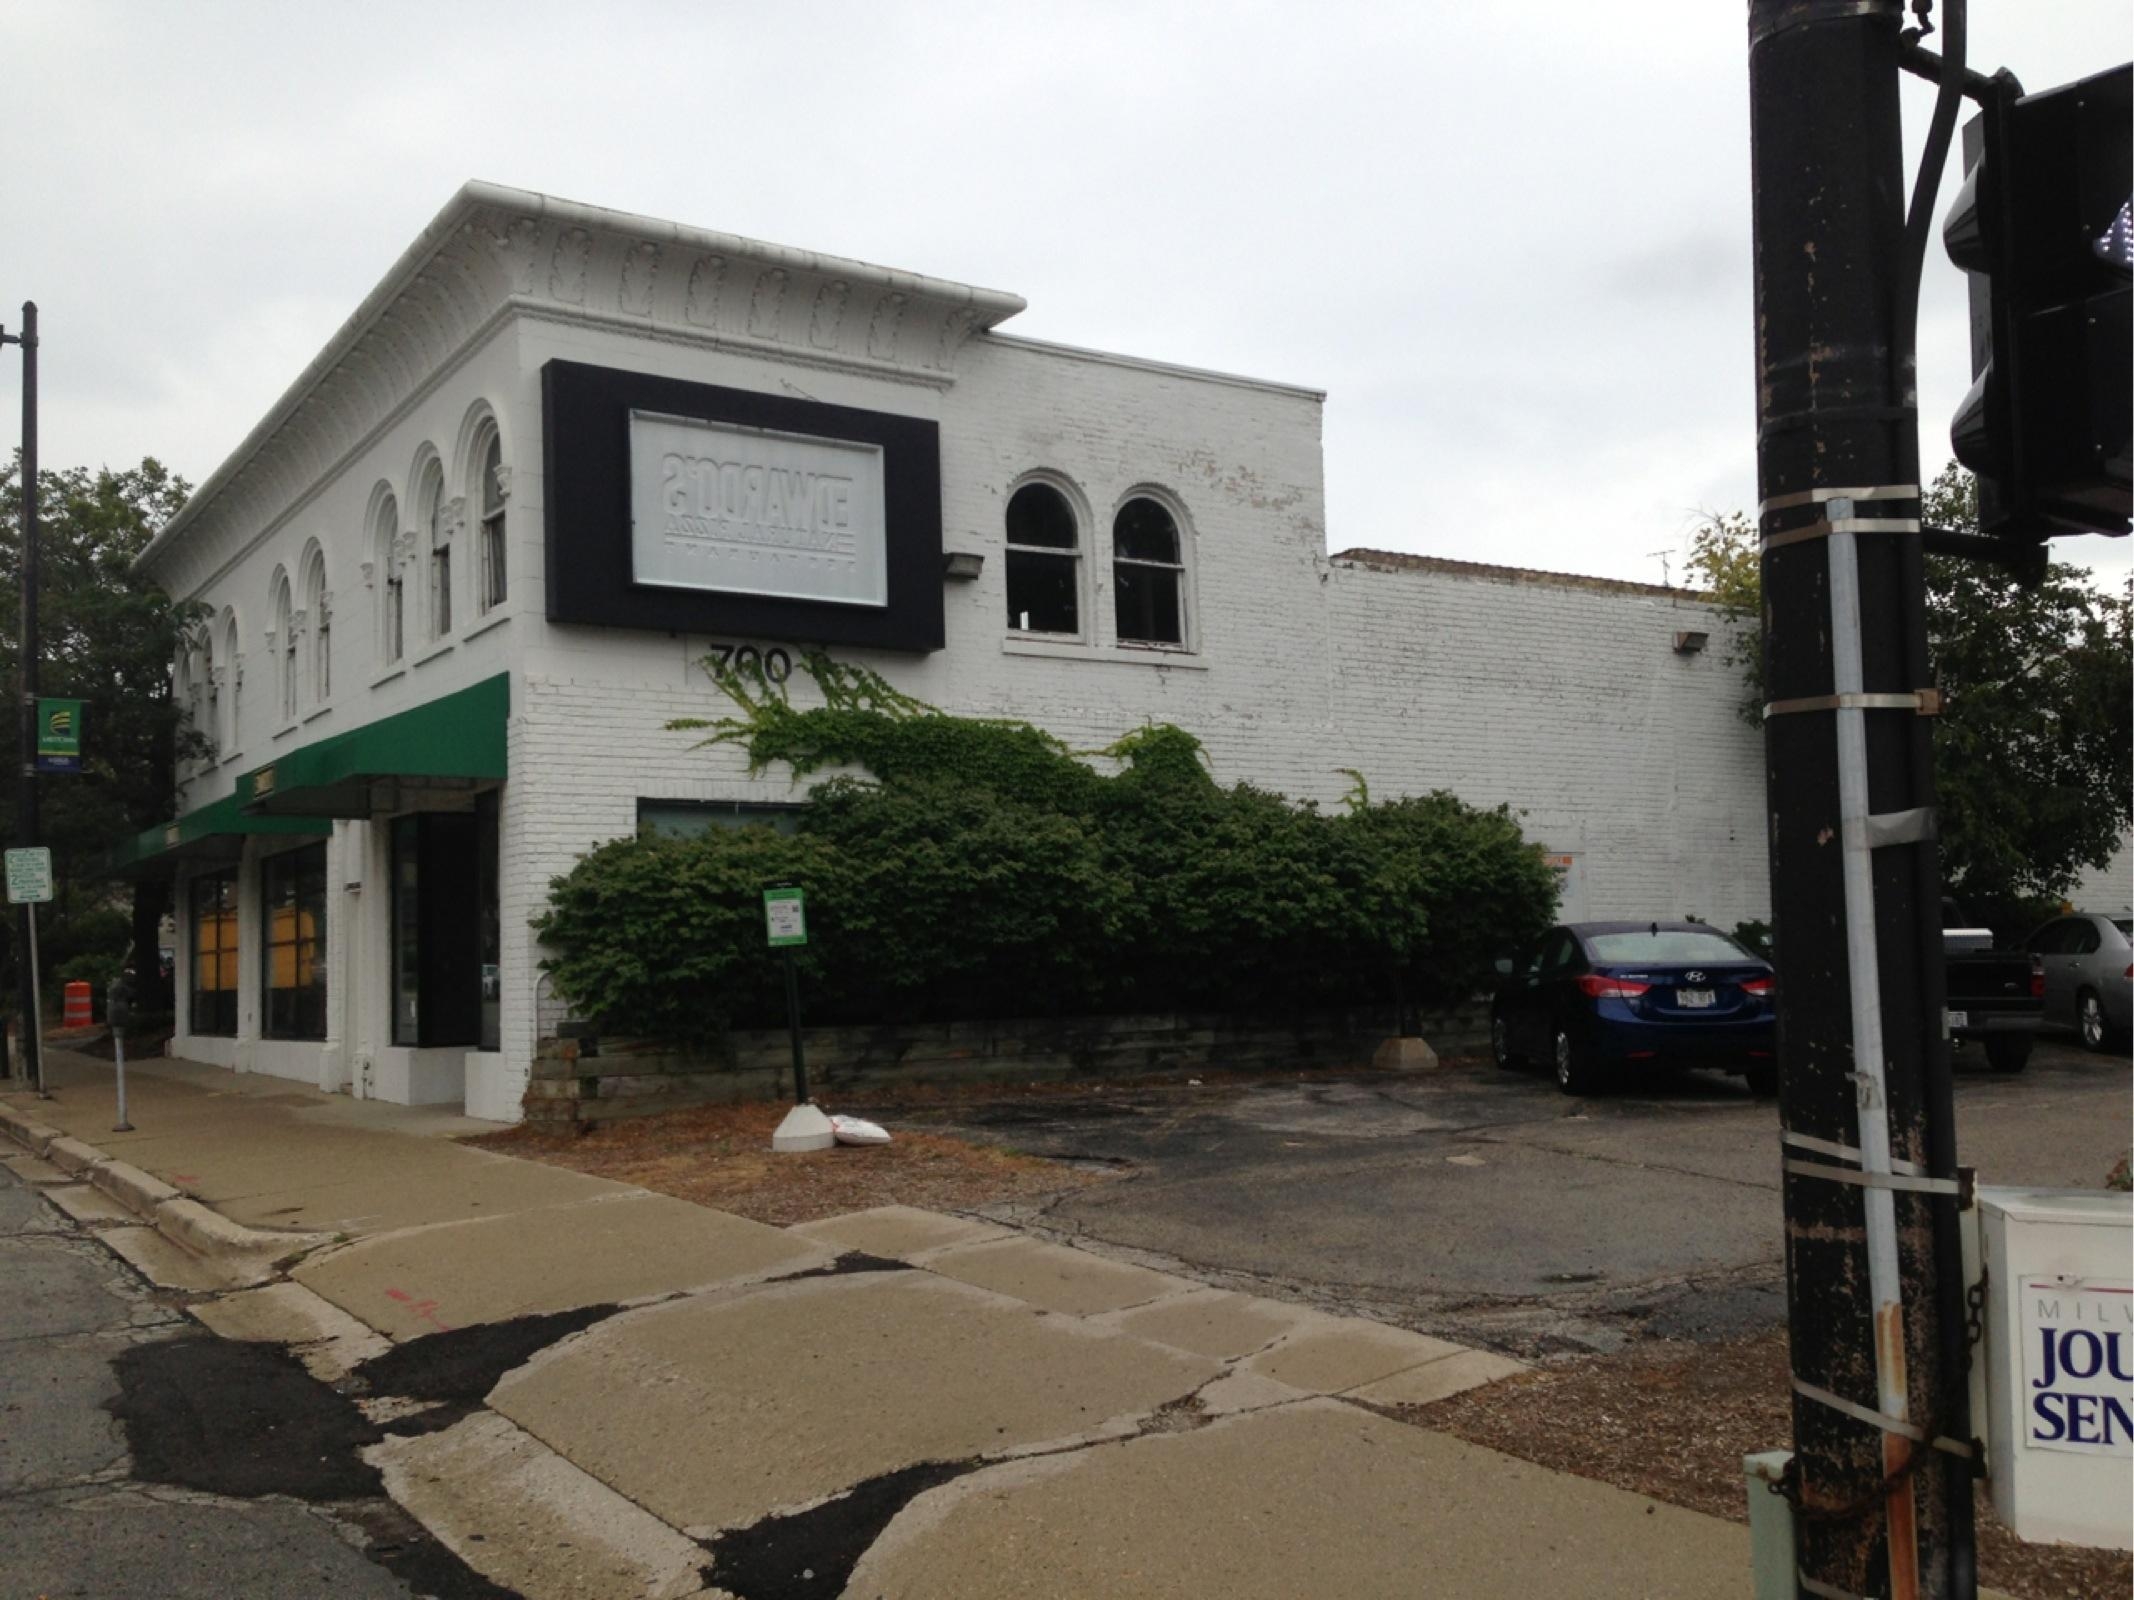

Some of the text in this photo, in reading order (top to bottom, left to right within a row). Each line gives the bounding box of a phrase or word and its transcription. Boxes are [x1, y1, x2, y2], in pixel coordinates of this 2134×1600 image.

[710, 643, 793, 684] 700
[2032, 1327, 2133, 1388] JOU
[2032, 1391, 2133, 1444] SEN
